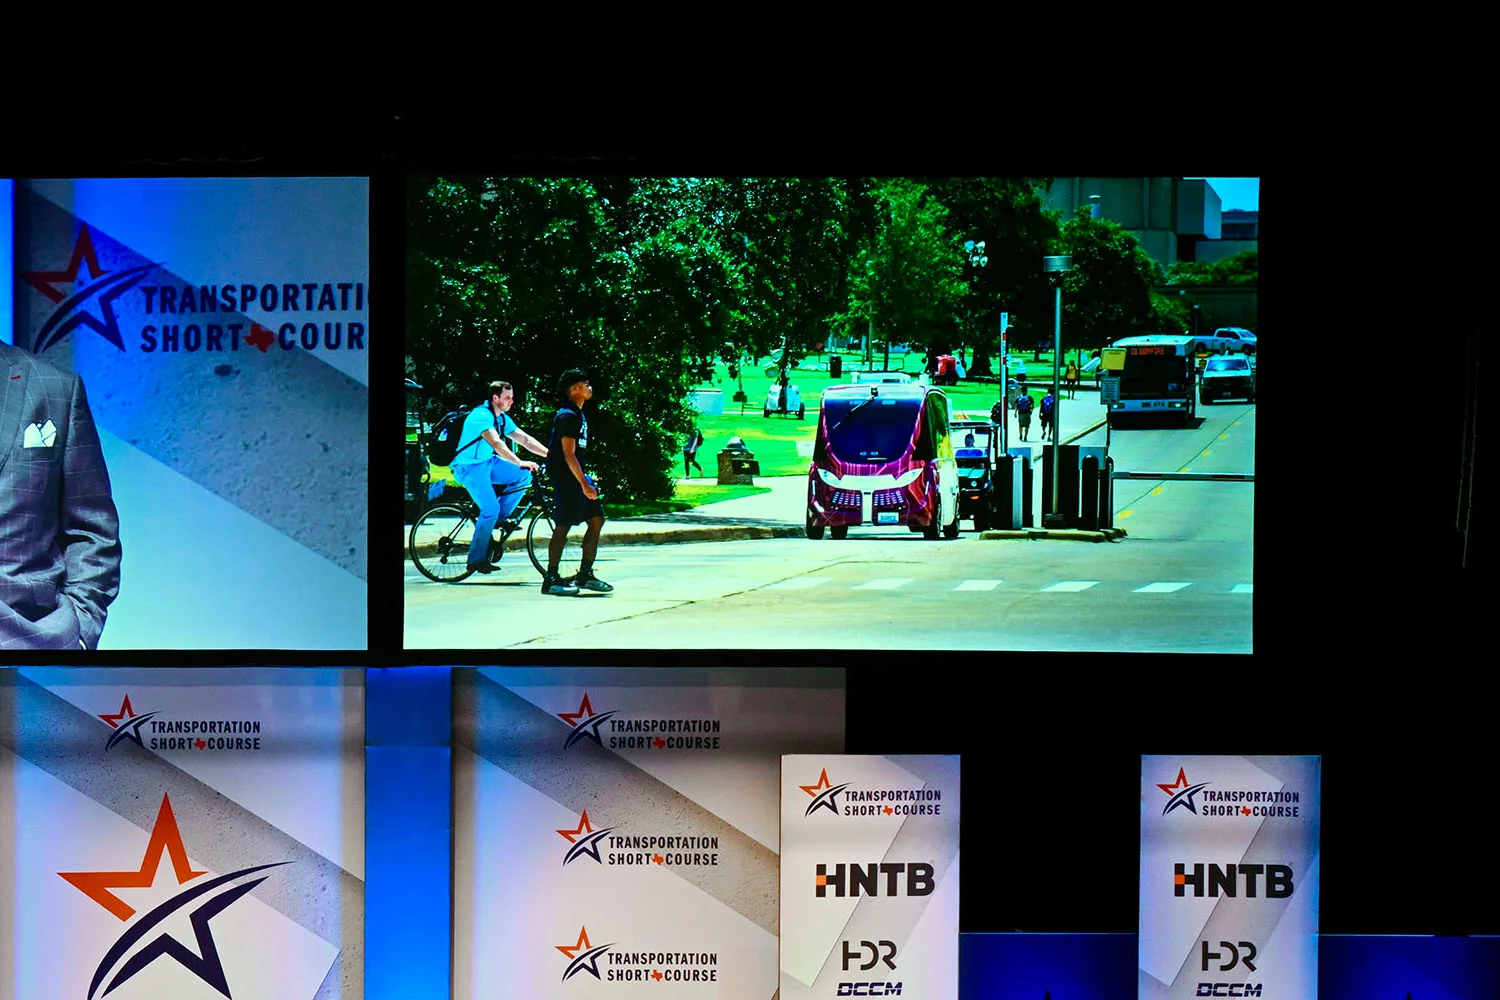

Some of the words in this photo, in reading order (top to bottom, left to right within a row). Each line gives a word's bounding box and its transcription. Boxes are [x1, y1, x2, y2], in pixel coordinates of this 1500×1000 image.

[140, 324, 243, 353] SHORT
[150, 720, 260, 734] TRANSPORTATION
[610, 719, 720, 733] TRANSPORTATION
[150, 737, 194, 750] SHORT
[207, 737, 260, 750] COURSE
[609, 737, 652, 749] SHORT
[666, 737, 720, 749] COURSE
[845, 790, 941, 801] TRANSPORTATION
[1203, 791, 1299, 803] TRANSPORTATION
[844, 805, 882, 816] SHORT
[894, 804, 940, 815] COURSE
[1203, 805, 1240, 816] SHORT
[1253, 806, 1299, 817] COURSE
[608, 836, 719, 849] TRANSPORTATION
[608, 853, 651, 866] SHORT
[665, 853, 718, 866] COURSE
[816, 863, 935, 897] HNTB
[1174, 863, 1295, 898] HNTB
[607, 952, 718, 966] TRANSPORTATION
[842, 940, 897, 971] HDR
[1201, 940, 1257, 972] HDR
[607, 969, 650, 982] SHORT
[664, 969, 717, 982] COURSE
[837, 982, 903, 996] DCCM
[1196, 983, 1263, 997] DCCM
